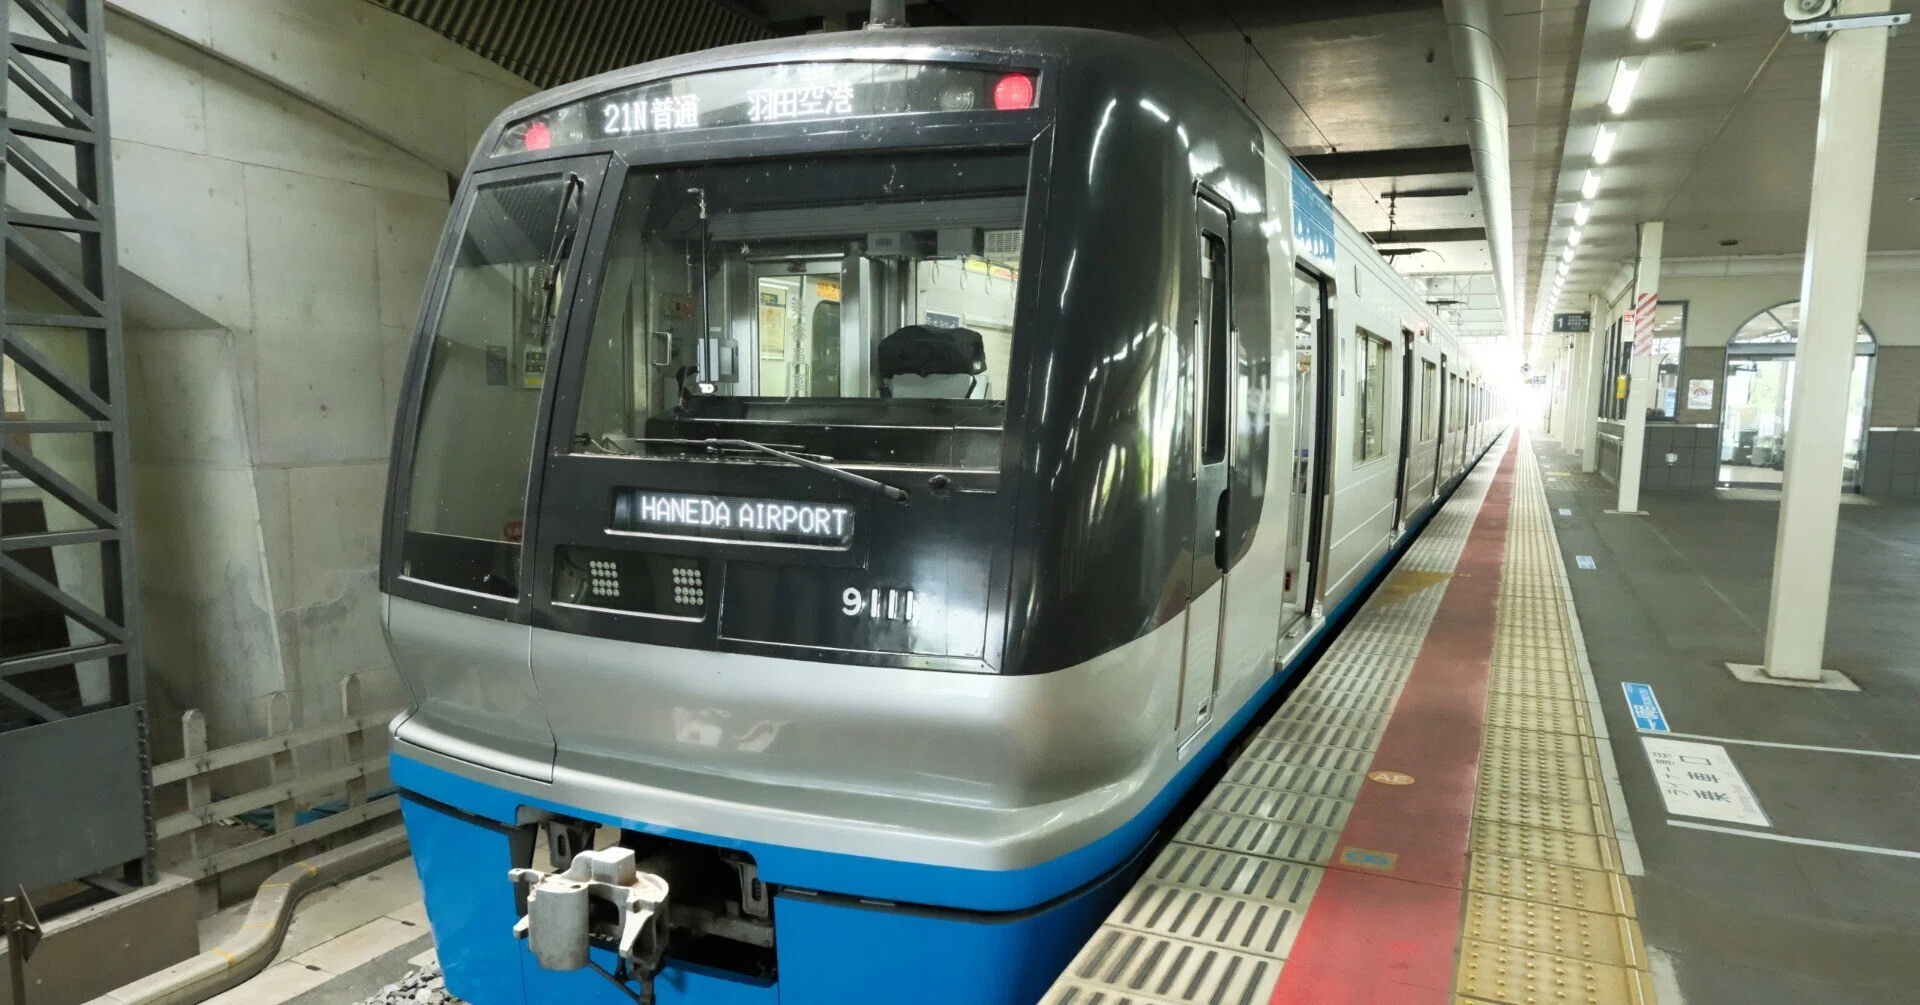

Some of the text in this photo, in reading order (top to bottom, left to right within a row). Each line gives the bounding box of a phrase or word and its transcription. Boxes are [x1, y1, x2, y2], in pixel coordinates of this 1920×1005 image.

[603, 79, 854, 134] 21N 普通 羽田空港
[1557, 317, 1563, 328] 1
[641, 495, 847, 536] HANEDA AIRPORT
[842, 587, 914, 621] 9111
[1679, 754, 1731, 803] 乗車口
